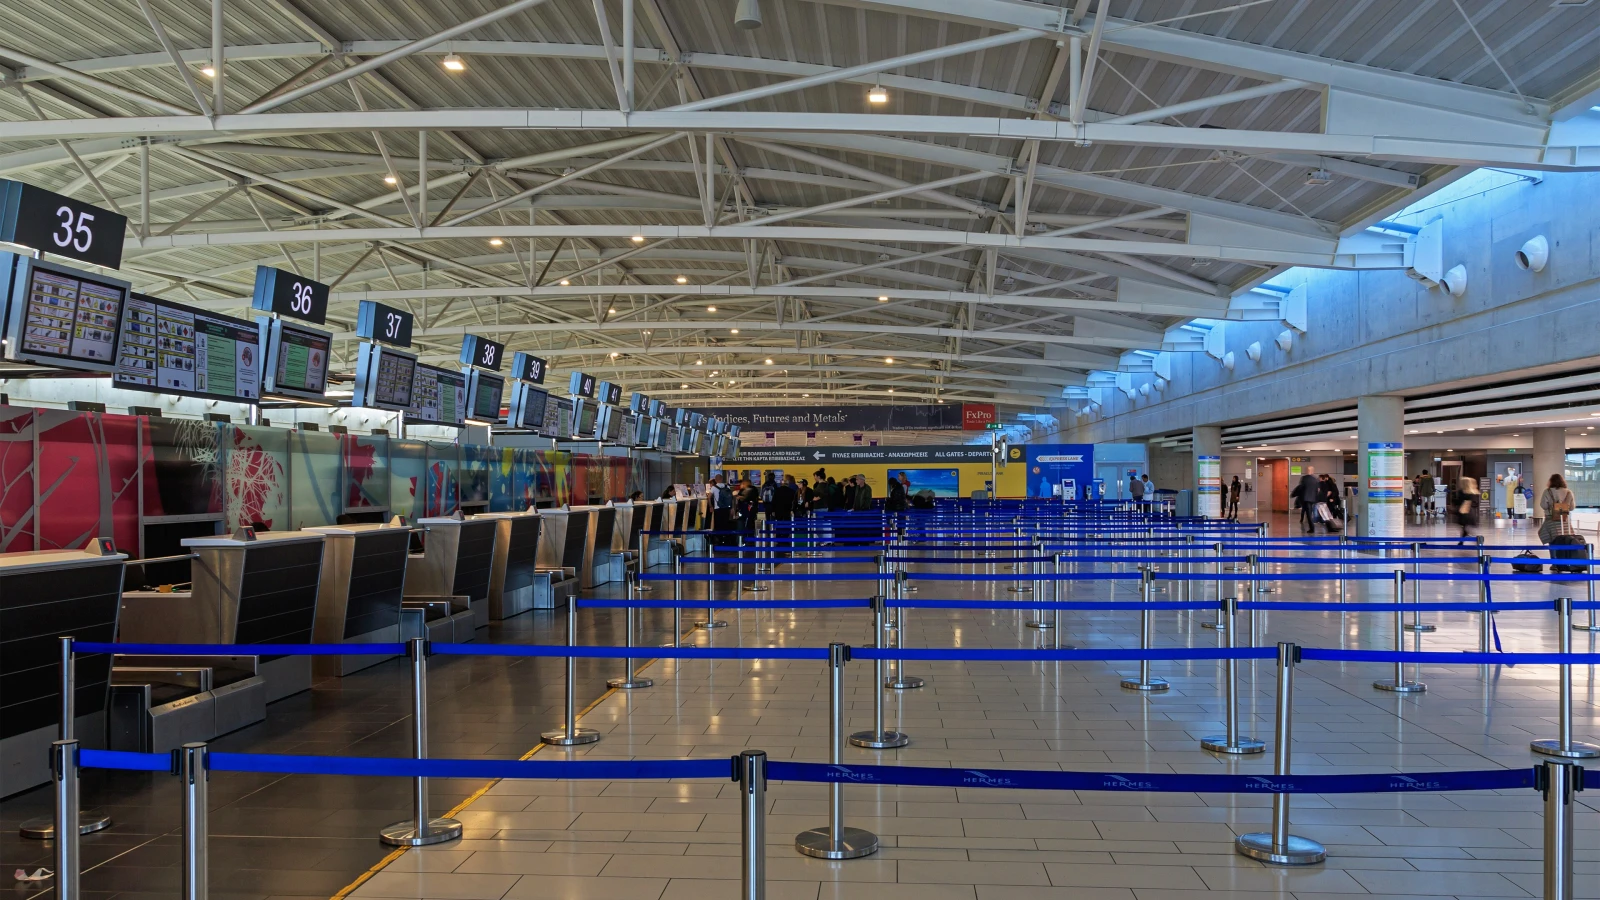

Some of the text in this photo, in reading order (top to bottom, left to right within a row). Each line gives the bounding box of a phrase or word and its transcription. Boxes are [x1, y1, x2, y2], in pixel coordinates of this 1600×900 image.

[53, 206, 95, 252] 35
[291, 282, 313, 315] 36
[386, 312, 402, 339] 37
[482, 343, 496, 366] 38
[530, 360, 541, 380] 39
[584, 378, 592, 394] 40
[611, 387, 619, 402] 41
[753, 413, 790, 424] Futures
[792, 412, 811, 424] and
[966, 410, 992, 419] FxPro
[963, 777, 1011, 785] HERMES
